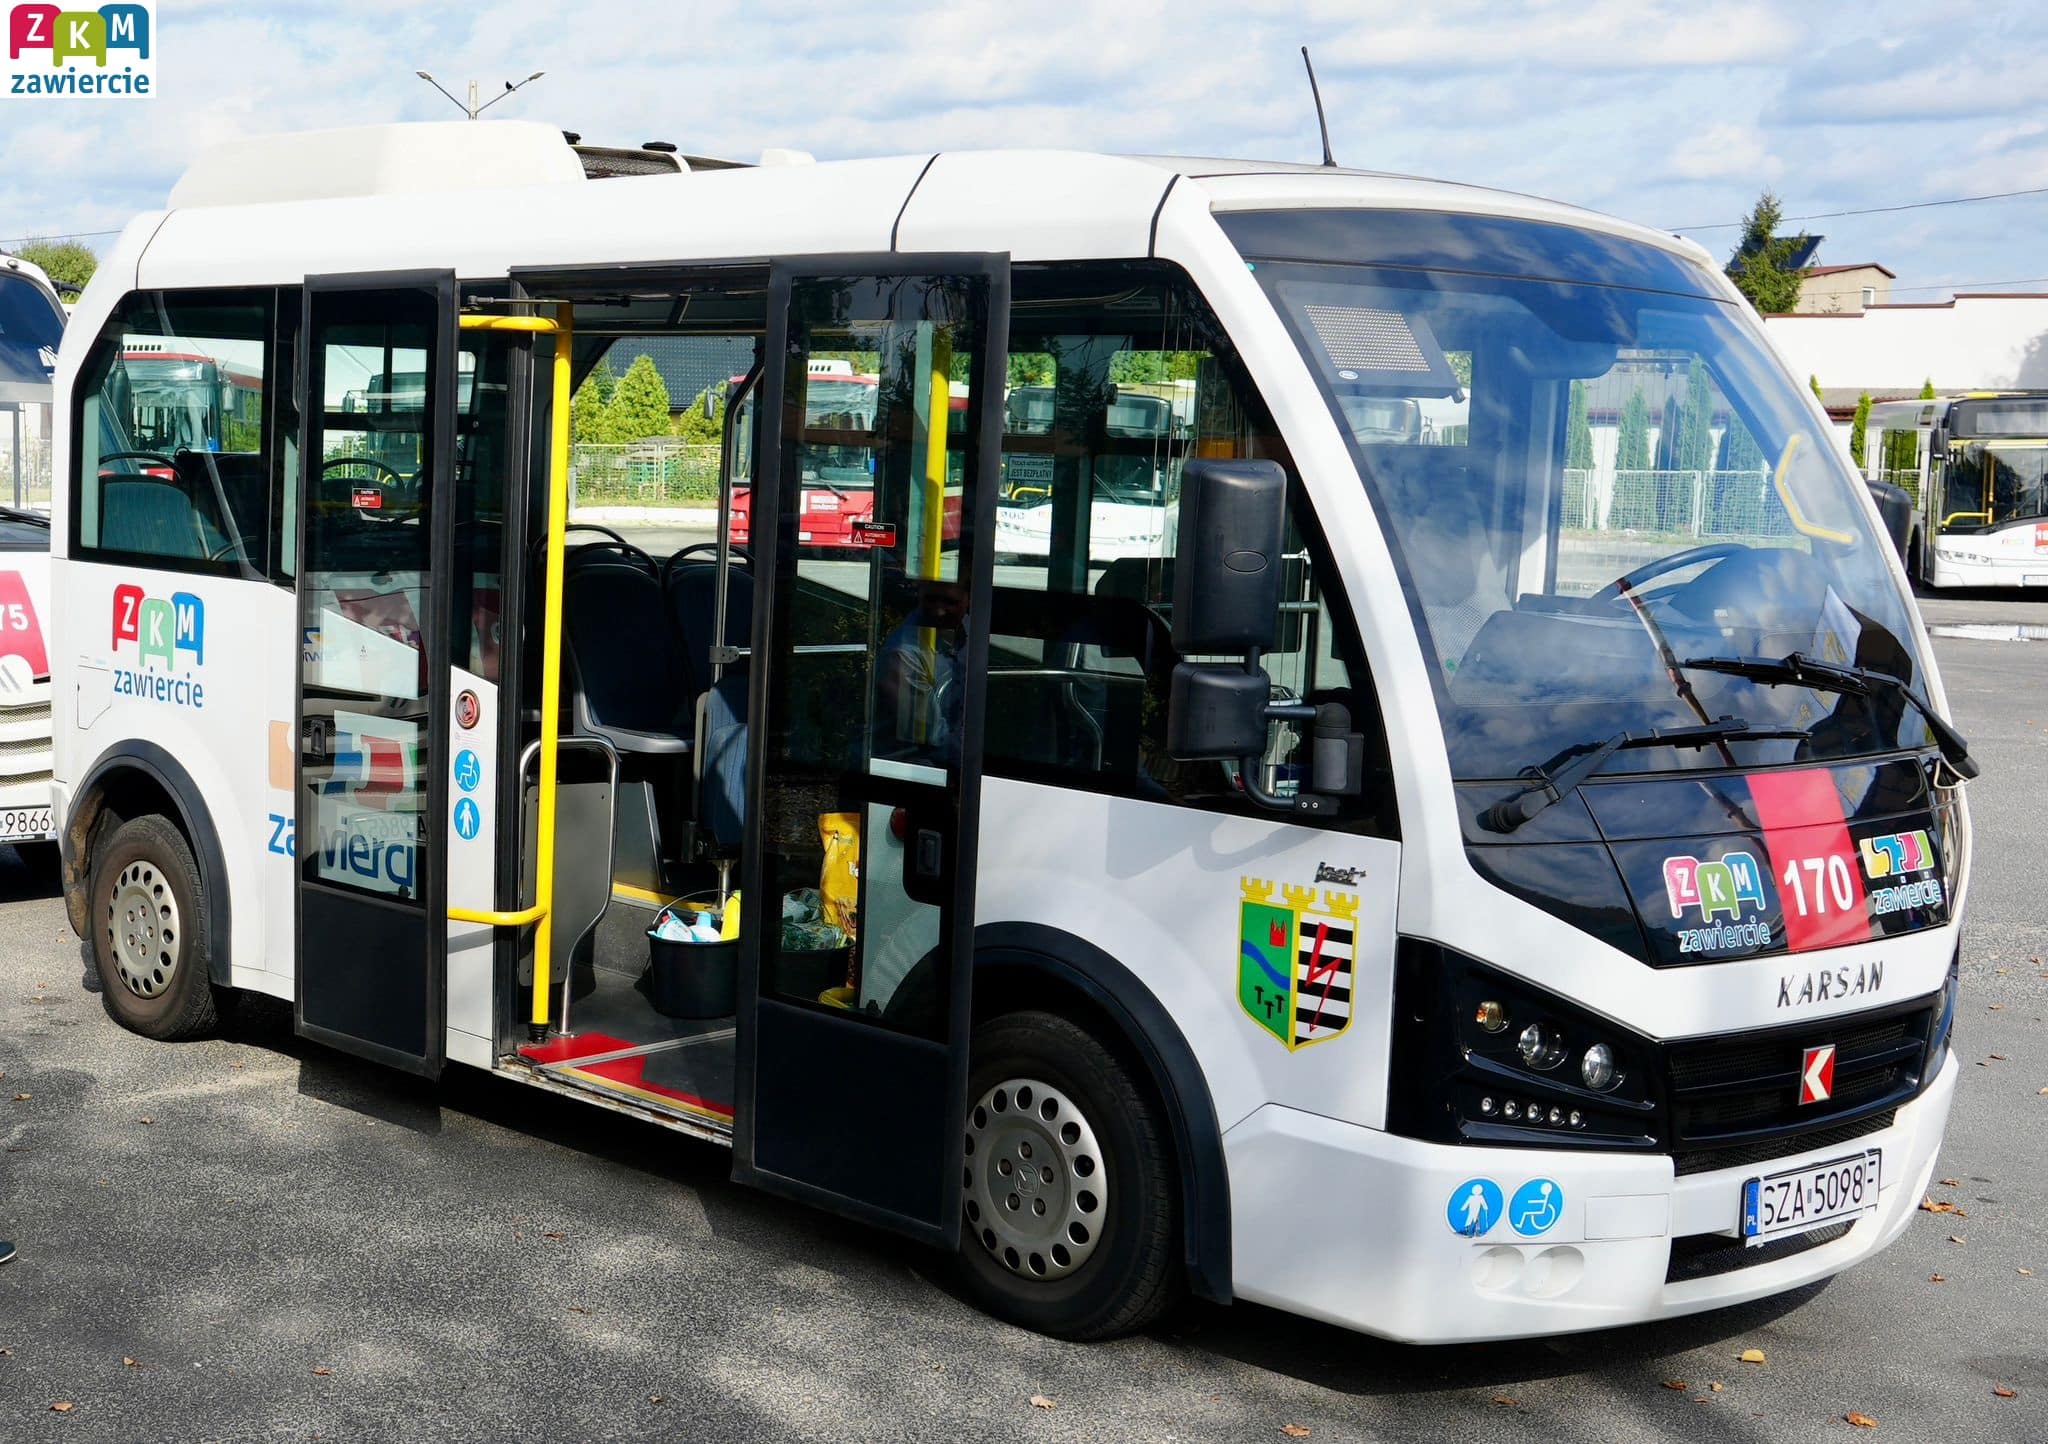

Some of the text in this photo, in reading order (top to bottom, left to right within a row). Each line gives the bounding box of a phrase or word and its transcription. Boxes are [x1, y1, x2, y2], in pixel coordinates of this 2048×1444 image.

[121, 596, 194, 648] ZKM
[114, 667, 203, 708] zawiercie
[1674, 863, 1753, 902] ZKM
[1784, 855, 1853, 916] 170
[1872, 871, 1943, 915] zawiercie
[1678, 915, 1771, 953] zawiercie
[1777, 961, 1883, 1008] KARSAN
[1746, 1215, 1757, 1227] PL
[1764, 1179, 1805, 1226] SZA
